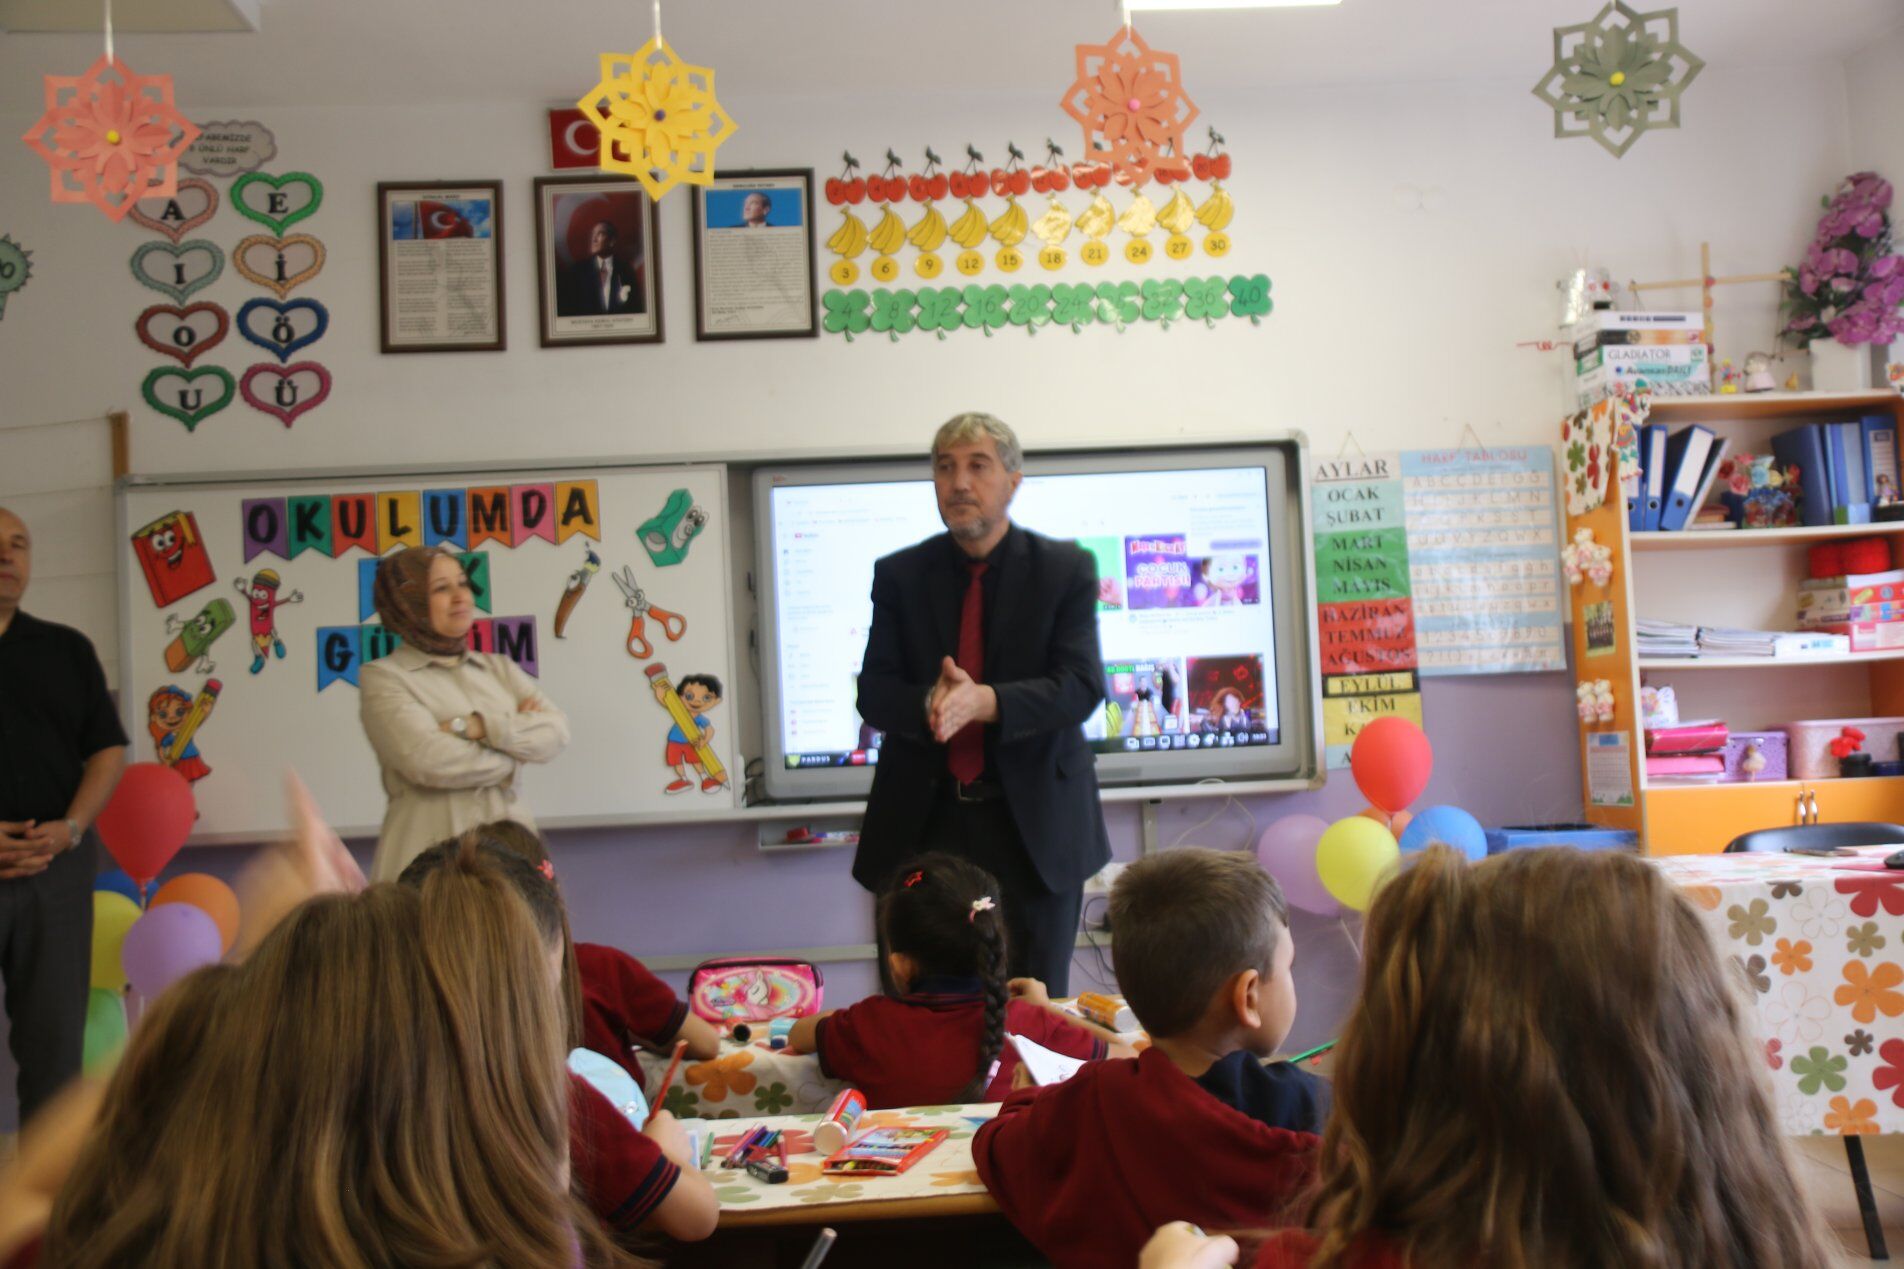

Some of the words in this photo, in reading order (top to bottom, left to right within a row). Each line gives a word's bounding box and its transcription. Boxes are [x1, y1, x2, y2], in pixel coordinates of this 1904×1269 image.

[160, 198, 185, 221] A
[267, 192, 289, 215] E
[275, 253, 287, 282] İ
[842, 267, 850, 279] 3
[881, 263, 890, 274] 6
[925, 259, 934, 270] 9
[963, 259, 979, 270] 12
[1003, 255, 1018, 266] 15
[1047, 252, 1061, 264] 18
[1088, 249, 1103, 260] 21
[1131, 247, 1147, 258] 24
[1172, 243, 1188, 255] 27
[1210, 239, 1226, 251] 30
[174, 263, 187, 285] I
[841, 302, 852, 319] 4
[889, 301, 899, 319] 8
[930, 298, 951, 320] 12
[977, 295, 996, 316] 16
[1016, 295, 1039, 316] 20
[1059, 293, 1081, 315] 24
[1238, 285, 1262, 307] 40
[172, 325, 196, 347] O
[272, 315, 295, 344] Ö
[1608, 348, 1671, 360] GLADIATOR
[178, 388, 202, 411] U
[274, 379, 298, 407] Ü
[1315, 459, 1389, 478] AYLAR
[1328, 485, 1379, 502] OCAK
[247, 486, 594, 544] OKULUMDA
[1326, 507, 1385, 527] ŞUBAT
[1333, 535, 1383, 551] MART
[1333, 556, 1387, 573] NİSAN
[1333, 577, 1391, 594] MAYIS
[1323, 604, 1405, 623] HAZİRAN
[1326, 626, 1407, 643] TEMMUZ
[1328, 648, 1410, 665] AĞUSTOS
[1339, 675, 1399, 691] EYLÜL
[1348, 696, 1396, 713] EKİM
[801, 755, 831, 764] PARDUS
